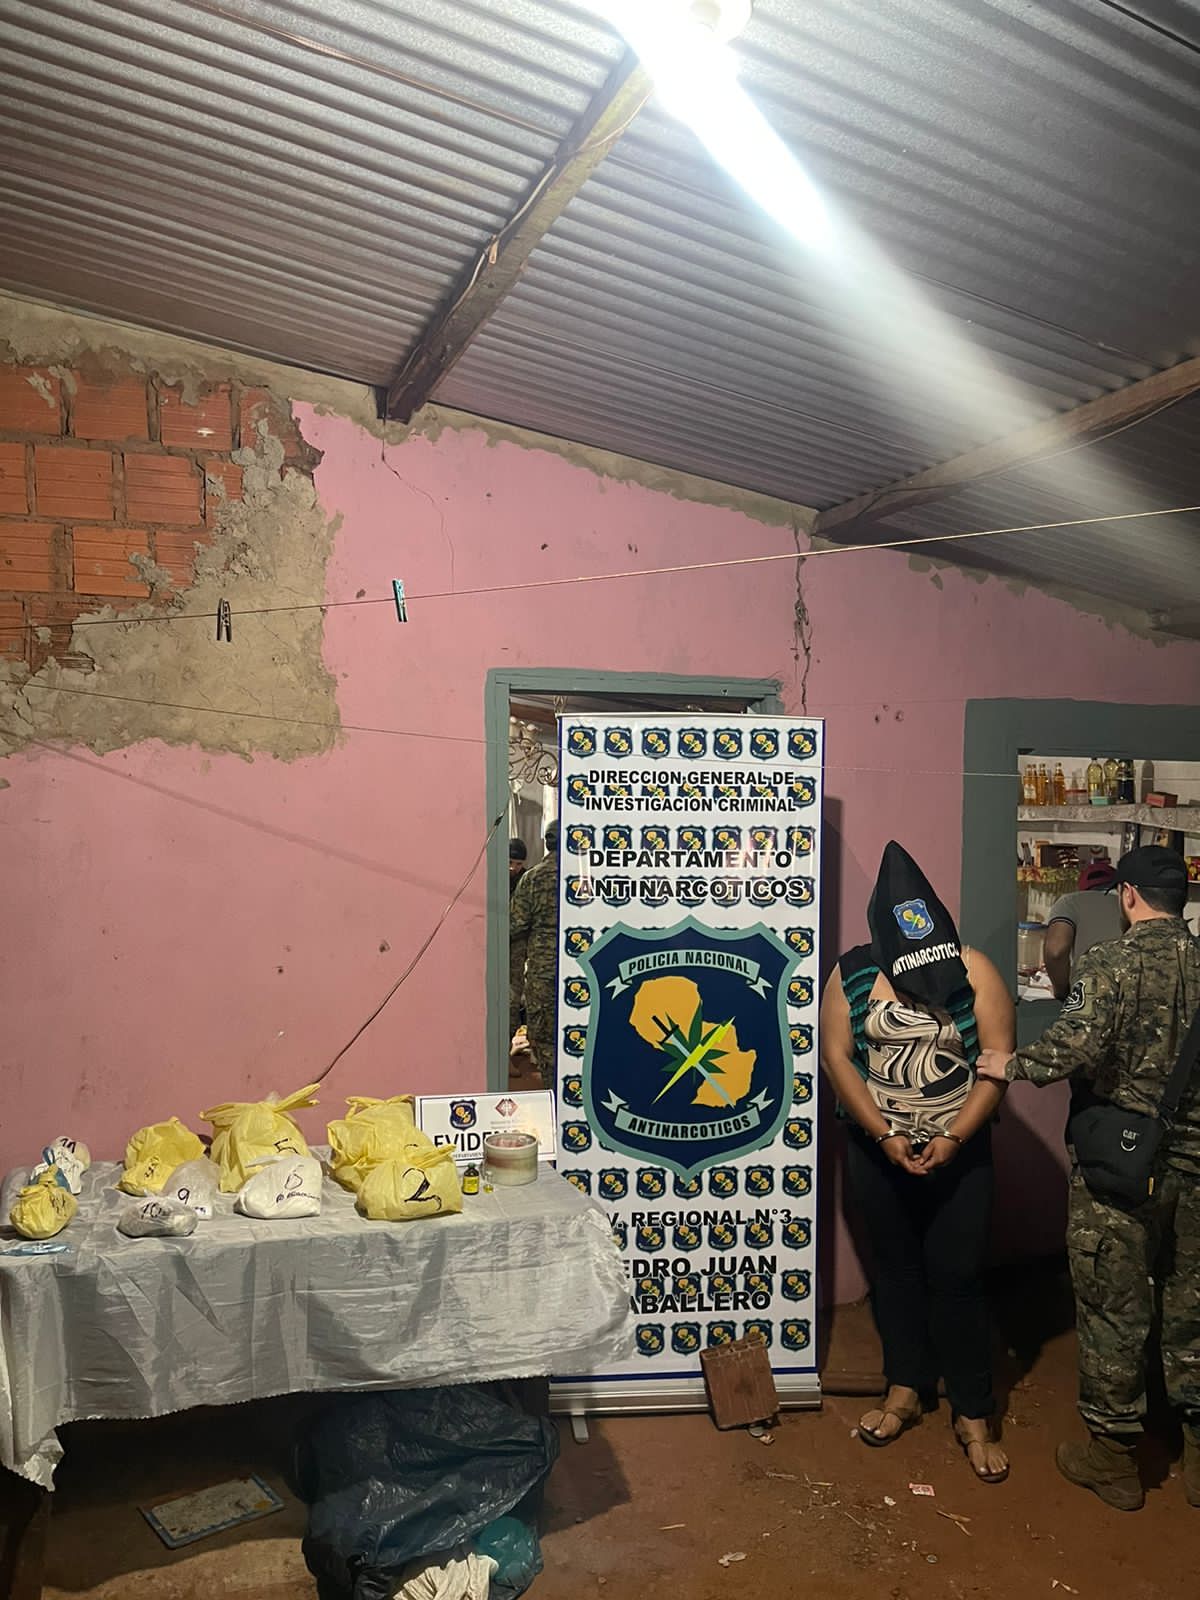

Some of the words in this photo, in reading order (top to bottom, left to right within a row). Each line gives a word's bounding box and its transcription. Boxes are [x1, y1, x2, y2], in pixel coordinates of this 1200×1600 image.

[589, 770, 682, 785] DIRECCION
[687, 771, 766, 785] GENERAL
[773, 771, 794, 785] DE
[586, 797, 713, 812] INVESTIGACION
[718, 798, 796, 812] CRIMINAL
[589, 850, 792, 868] DEPARTAMENTO
[576, 879, 804, 898] ANTINARCOTICOS
[628, 951, 679, 975] POLICIA
[685, 951, 751, 975] NACIONAL
[628, 1115, 751, 1138] ANTINARCOTICOS
[1122, 1129, 1137, 1141] CAT
[402, 1167, 441, 1210] 2
[606, 1212, 623, 1228] V.
[632, 1210, 747, 1227] REGIONAL
[622, 1258, 691, 1278] EDRO
[701, 1256, 777, 1276] JUAN
[630, 1291, 771, 1314] ABALLERO
